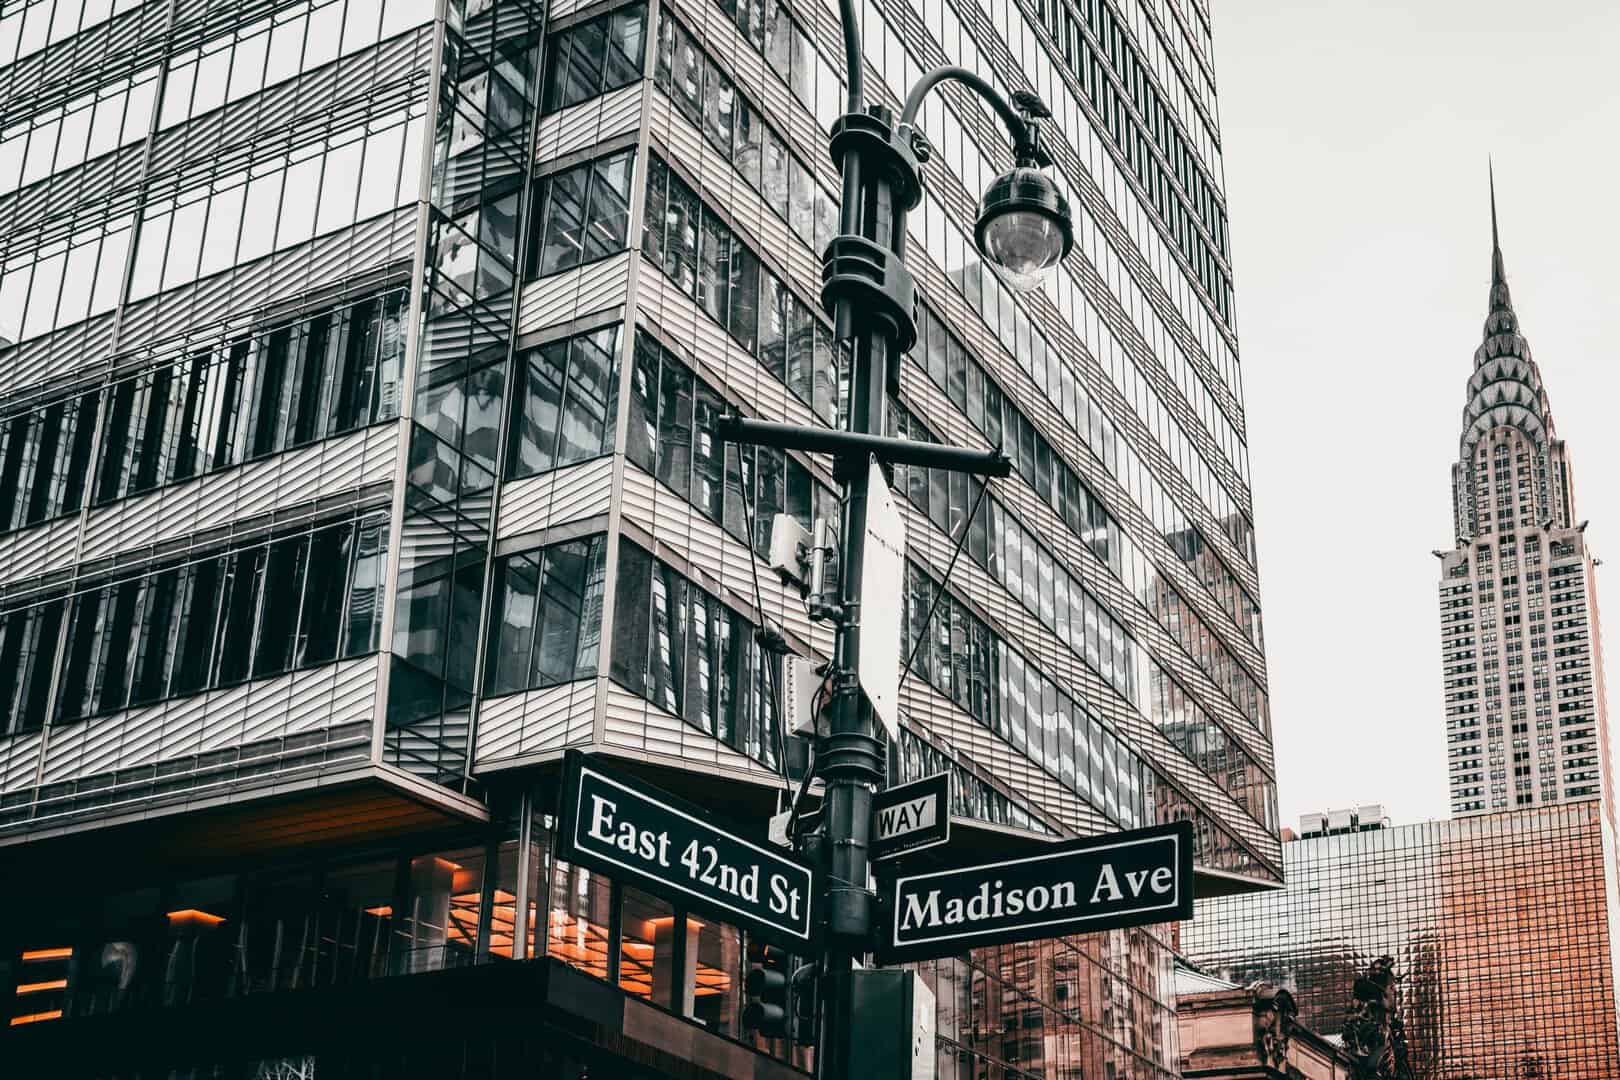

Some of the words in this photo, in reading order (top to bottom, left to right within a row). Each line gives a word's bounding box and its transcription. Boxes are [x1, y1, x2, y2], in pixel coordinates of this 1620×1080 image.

[879, 800, 927, 837] WAY
[587, 794, 670, 867] East
[680, 839, 760, 904] 42nd
[768, 873, 801, 920] St
[900, 880, 1077, 931] Madison
[1090, 863, 1173, 904] Ave
